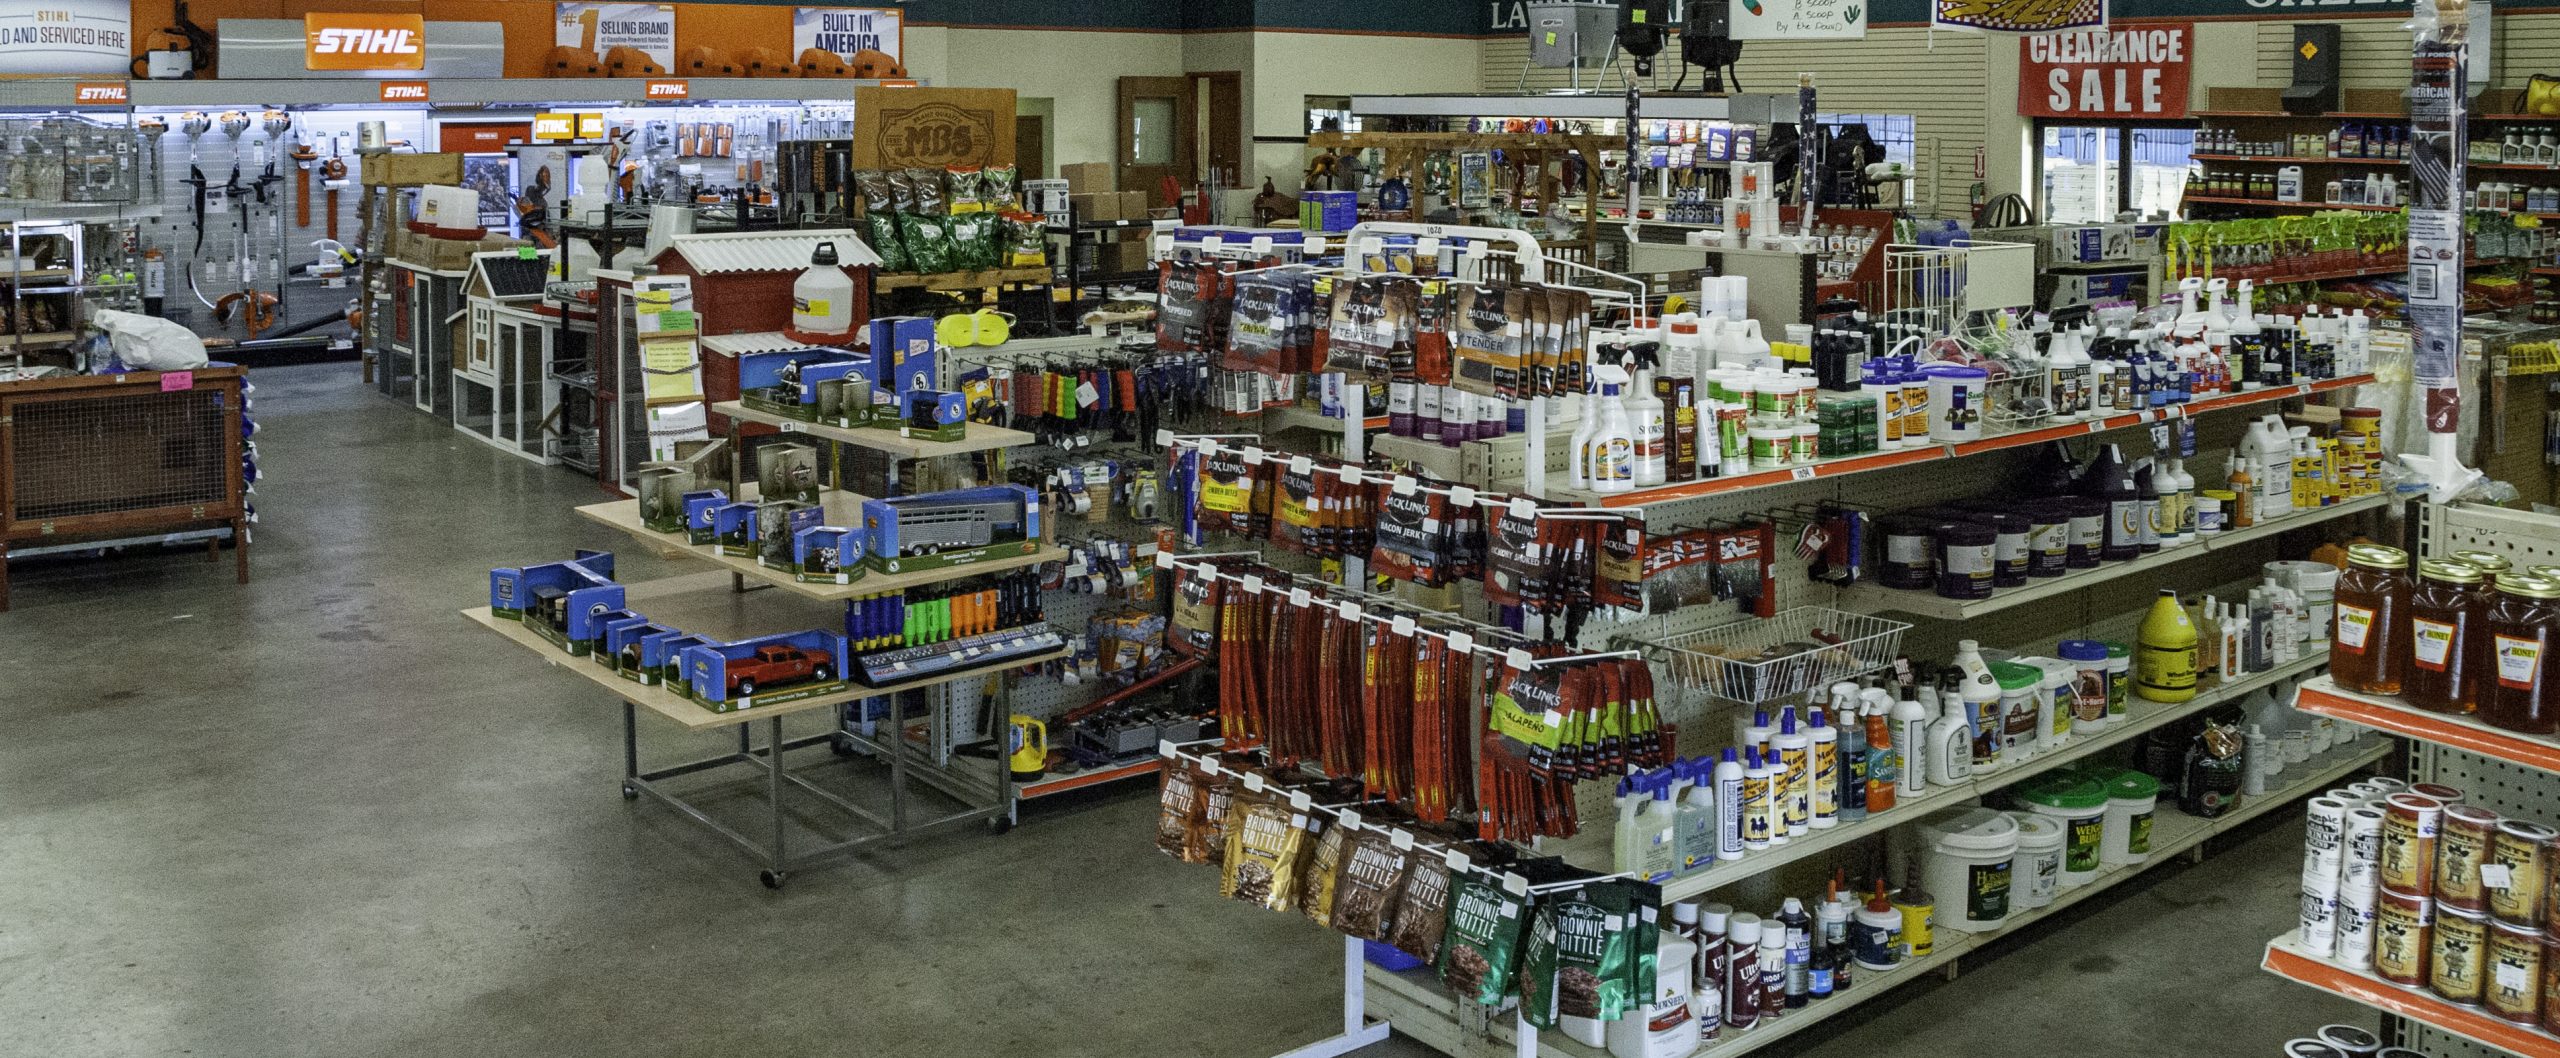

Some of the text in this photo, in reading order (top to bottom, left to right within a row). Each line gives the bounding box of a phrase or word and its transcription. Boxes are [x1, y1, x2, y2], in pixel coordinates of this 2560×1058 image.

[37, 10, 71, 22] STIHL
[822, 13, 872, 33] BUILT IN
[13, 26, 126, 49] AND SERVICED HERE
[601, 21, 669, 35] SELLING BRAND
[314, 28, 419, 54] STIHL
[815, 33, 880, 53] AMERICA
[2029, 29, 2184, 64] CLEARANCE
[79, 87, 127, 100] STIHL
[383, 86, 426, 98] STIHL
[649, 83, 687, 95] STIHL
[2048, 67, 2162, 113] SALE
[535, 119, 572, 133] STIHL
[894, 124, 973, 158] MBS
[1466, 335, 1503, 352] TENDER
[1385, 495, 1406, 512] JACK
[1380, 521, 1427, 542] BACON JERKY
[1496, 517, 1517, 534] JACK
[2347, 614, 2371, 627] HONEY
[2426, 629, 2451, 641] HONEY
[2511, 646, 2538, 659] HONEY
[1508, 677, 1531, 698] JACK
[1166, 777, 1195, 800] BROWNI
[1160, 791, 1193, 813] BRITTLE
[1245, 813, 1289, 839] BROWNIE
[1242, 827, 1286, 852] BRITTLE
[1353, 846, 1399, 873] BROWNIE
[1347, 859, 1394, 888] BRITTLE
[1457, 892, 1501, 925] BROWNIE
